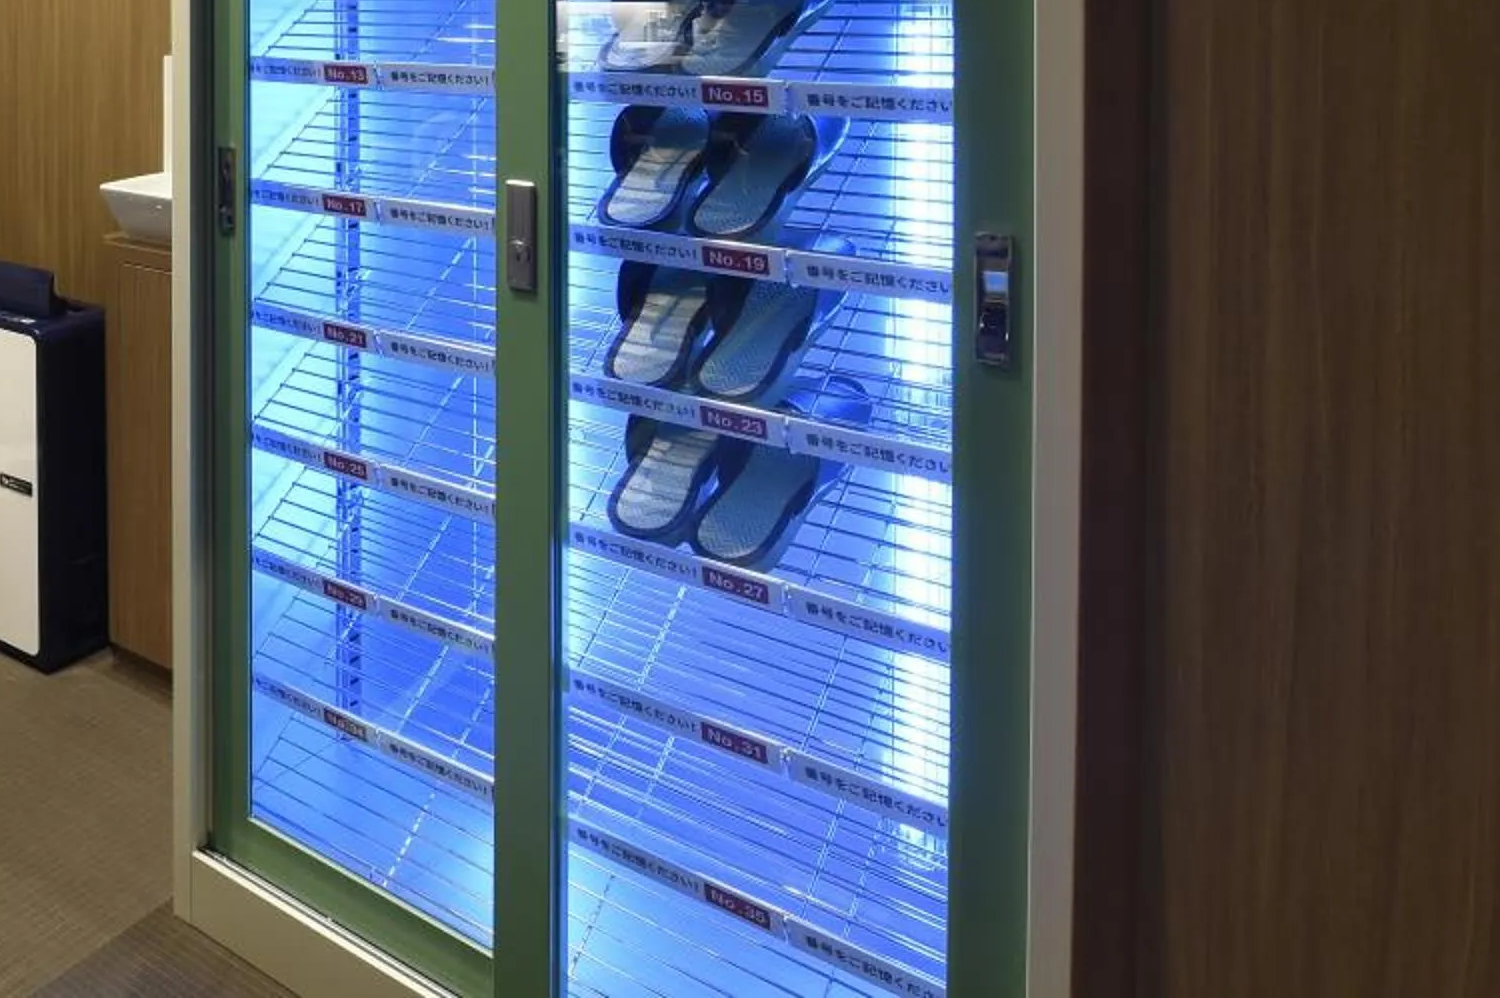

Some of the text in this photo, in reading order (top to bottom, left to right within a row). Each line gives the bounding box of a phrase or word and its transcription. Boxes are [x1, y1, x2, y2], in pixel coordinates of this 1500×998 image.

[708, 87, 764, 103] No.15
[709, 251, 765, 272] No.19
[707, 412, 763, 435] No.23
